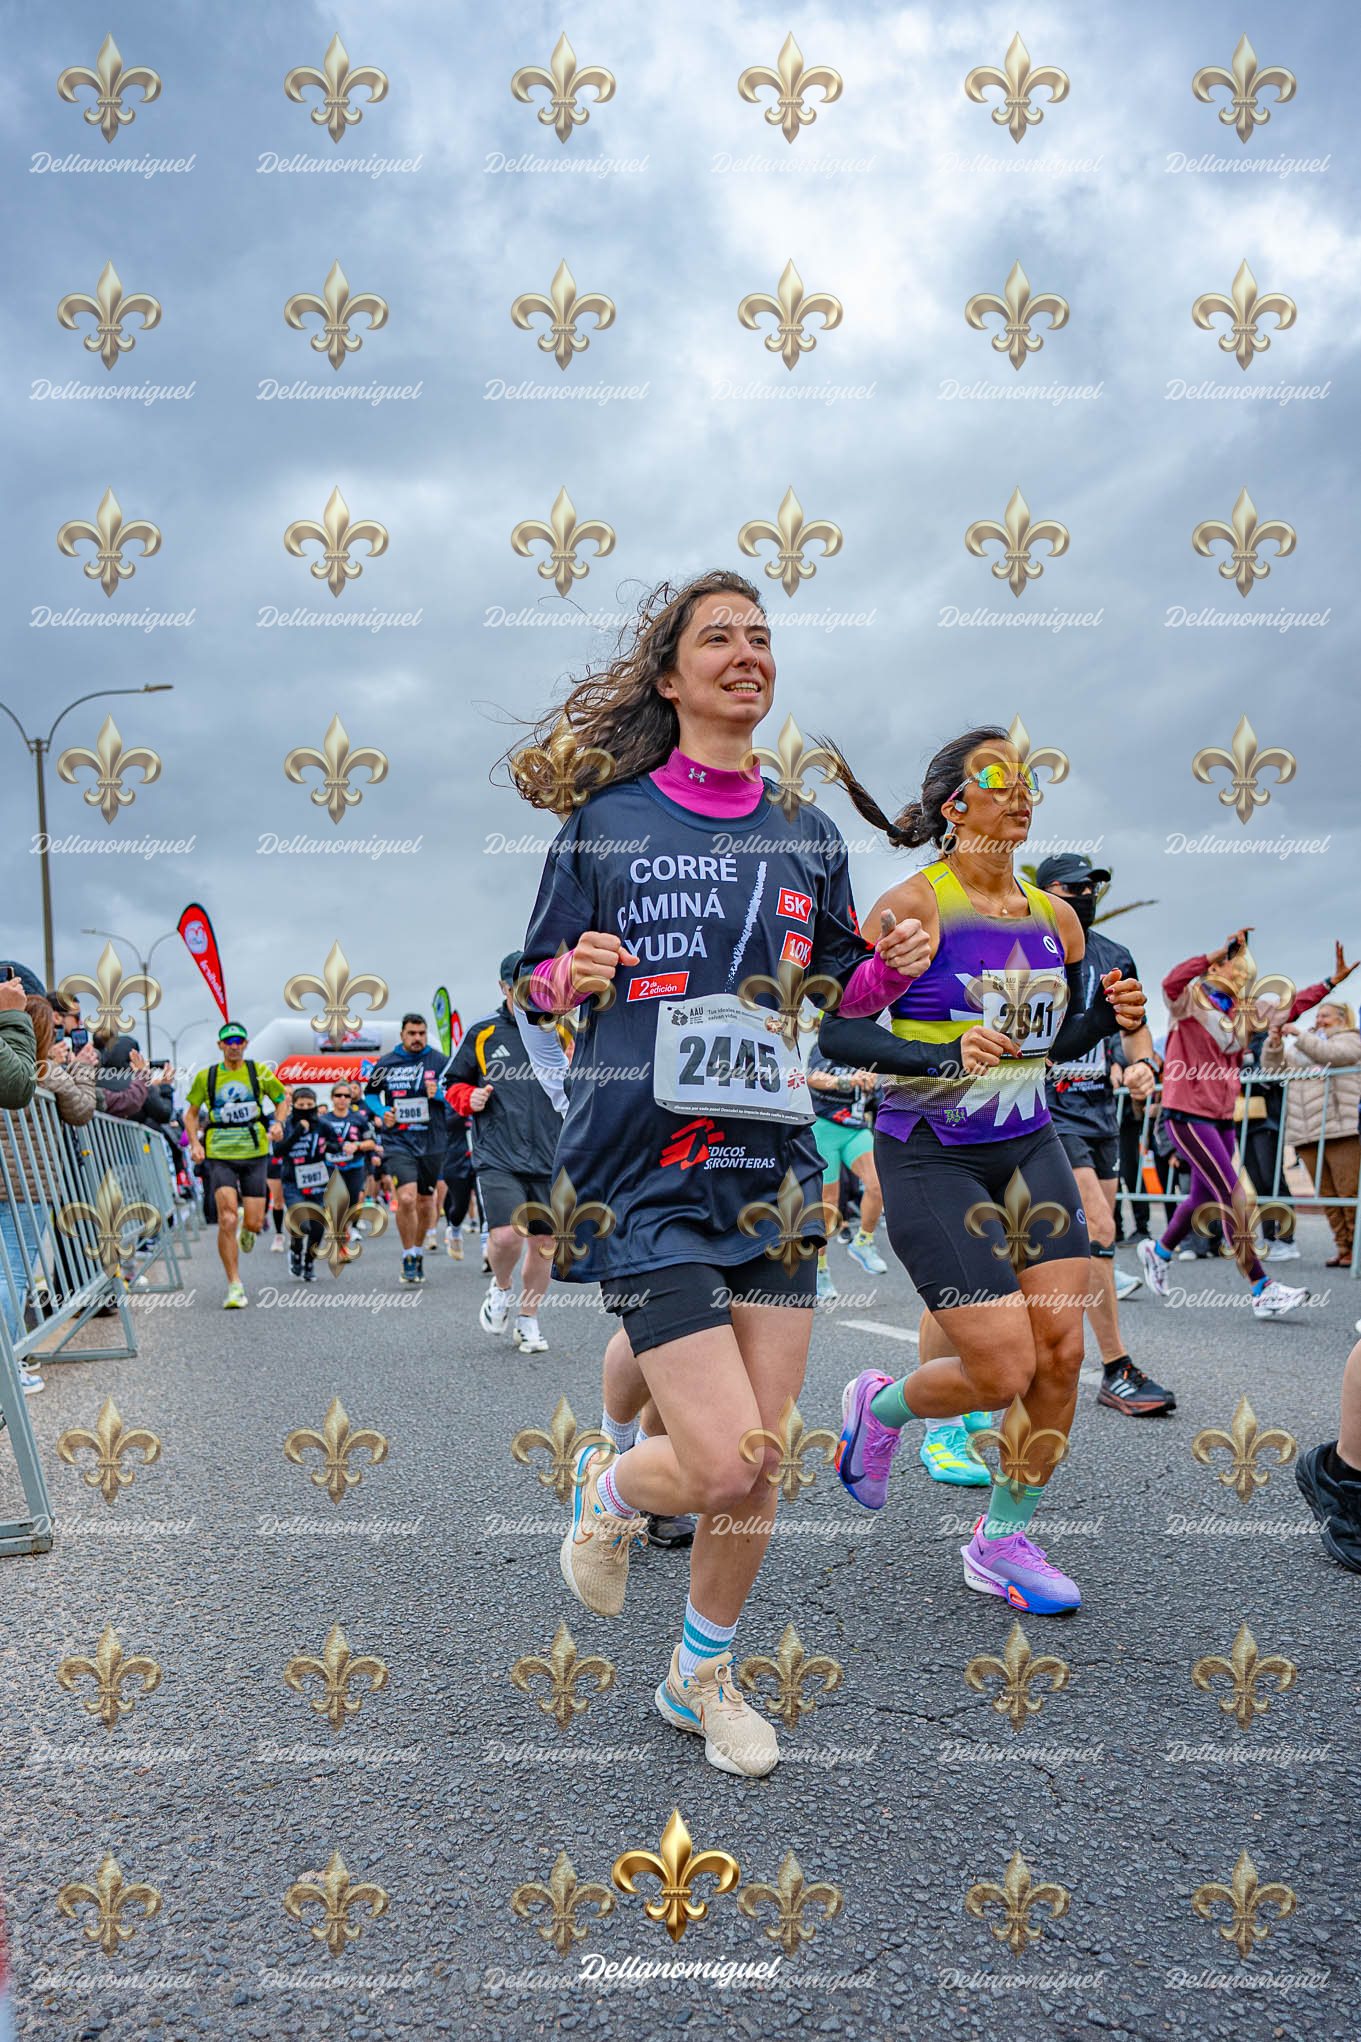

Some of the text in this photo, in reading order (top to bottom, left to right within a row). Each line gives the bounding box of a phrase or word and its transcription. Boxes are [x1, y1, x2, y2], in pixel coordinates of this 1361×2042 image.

[630, 853, 737, 883] CORRÉ
[784, 894, 806, 917] 5K
[624, 925, 708, 961] YUDÁ
[790, 938, 811, 963] 10K
[649, 984, 678, 995] edición
[690, 1007, 704, 1017] AAU
[1000, 1001, 1054, 1040] 2941
[680, 1036, 781, 1093] 2445
